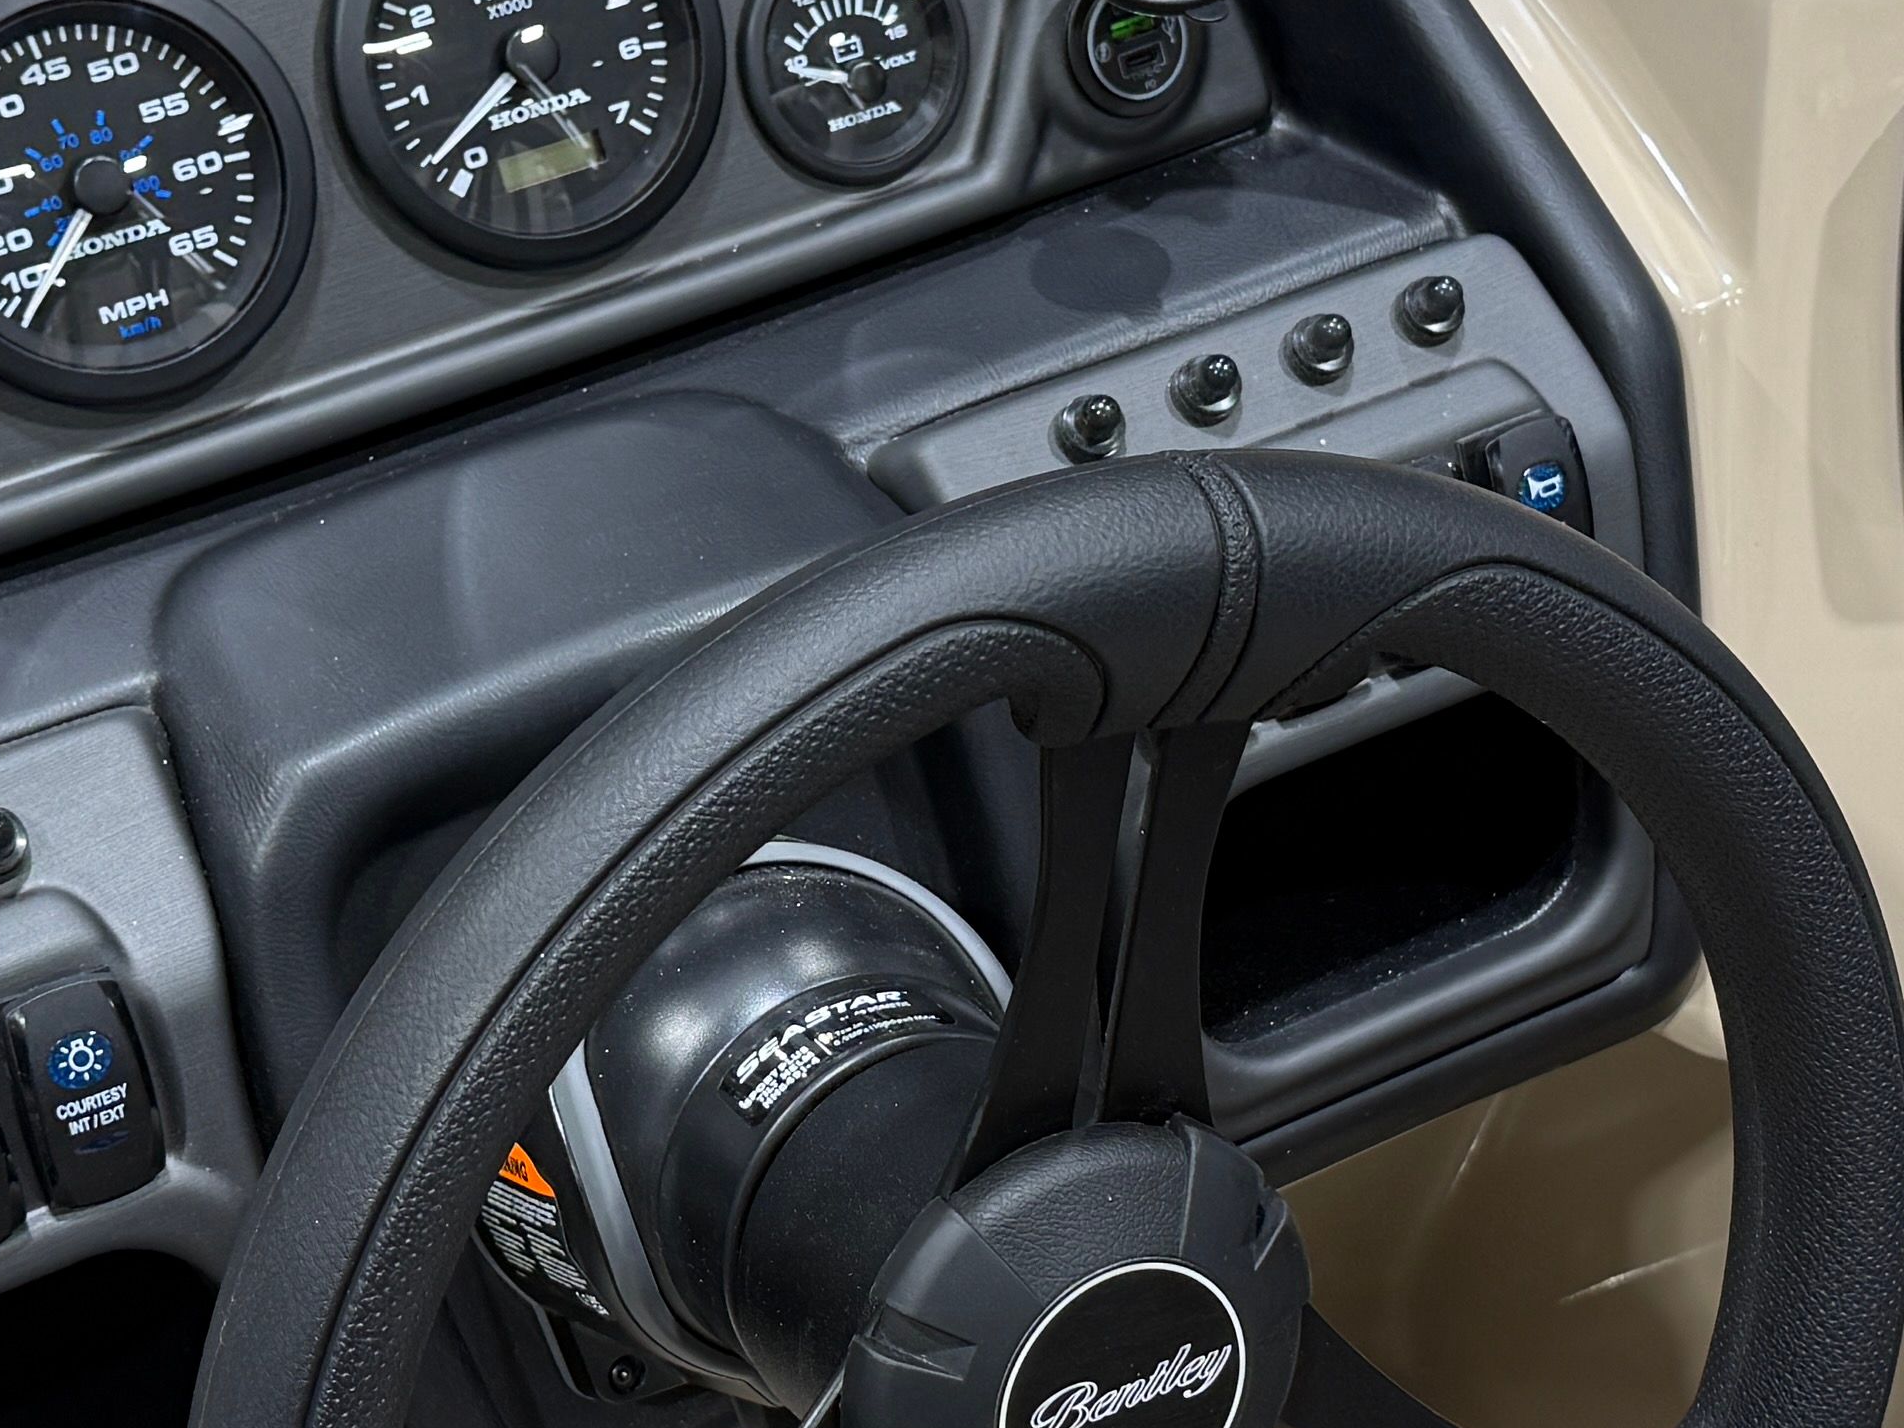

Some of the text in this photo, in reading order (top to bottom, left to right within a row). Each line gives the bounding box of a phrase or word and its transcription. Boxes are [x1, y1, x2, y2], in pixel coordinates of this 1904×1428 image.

[409, 4, 436, 29] 2
[618, 37, 642, 60] 6
[879, 50, 917, 70] VOLT
[20, 56, 71, 86] 45
[87, 52, 140, 83] 50
[138, 92, 190, 123] 55
[410, 84, 429, 106] 1
[488, 88, 592, 131] HONDA
[607, 100, 631, 124] 7
[827, 101, 902, 132] HONDA
[58, 132, 81, 150] 70
[40, 153, 64, 172] 60
[172, 151, 223, 182] 60
[463, 145, 488, 170] 0
[168, 225, 219, 257] 65
[98, 288, 170, 325] MPH
[118, 316, 162, 339] km/h
[56, 1082, 128, 1121] COURTESY
